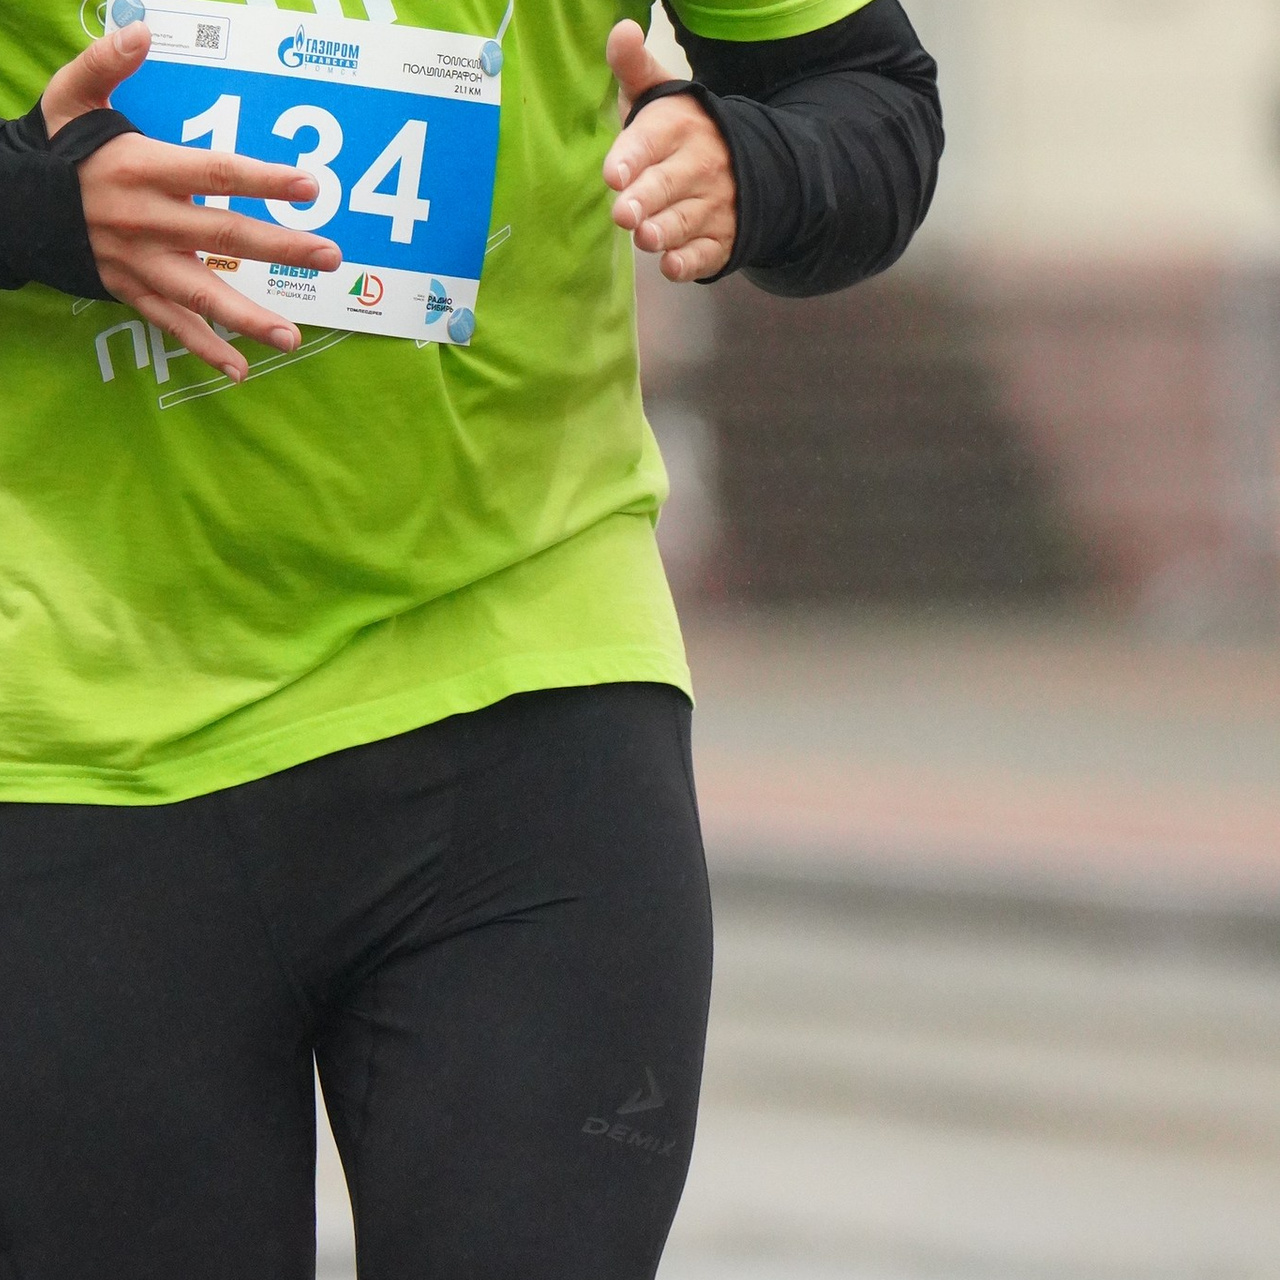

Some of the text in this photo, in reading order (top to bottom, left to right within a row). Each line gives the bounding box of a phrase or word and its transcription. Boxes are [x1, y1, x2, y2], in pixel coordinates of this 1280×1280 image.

[306, 38, 360, 59] ГАЗПРОМ
[306, 54, 358, 69] ТРАНСГАЗ
[304, 65, 357, 77] ТОМСК
[402, 63, 482, 83] ПОЛУМАРАФОН
[468, 87, 482, 96] КМ
[180, 94, 431, 245] 134
[206, 258, 238, 270] PRO
[269, 263, 319, 280] СИБУР
[267, 278, 317, 293] ФОРМУЛА
[266, 288, 317, 302] ХОРОШИХ ДЕЛ
[427, 295, 453, 306] РАДИО
[425, 303, 454, 314] СИБИРЬ
[582, 1116, 676, 1156] DEMIX
